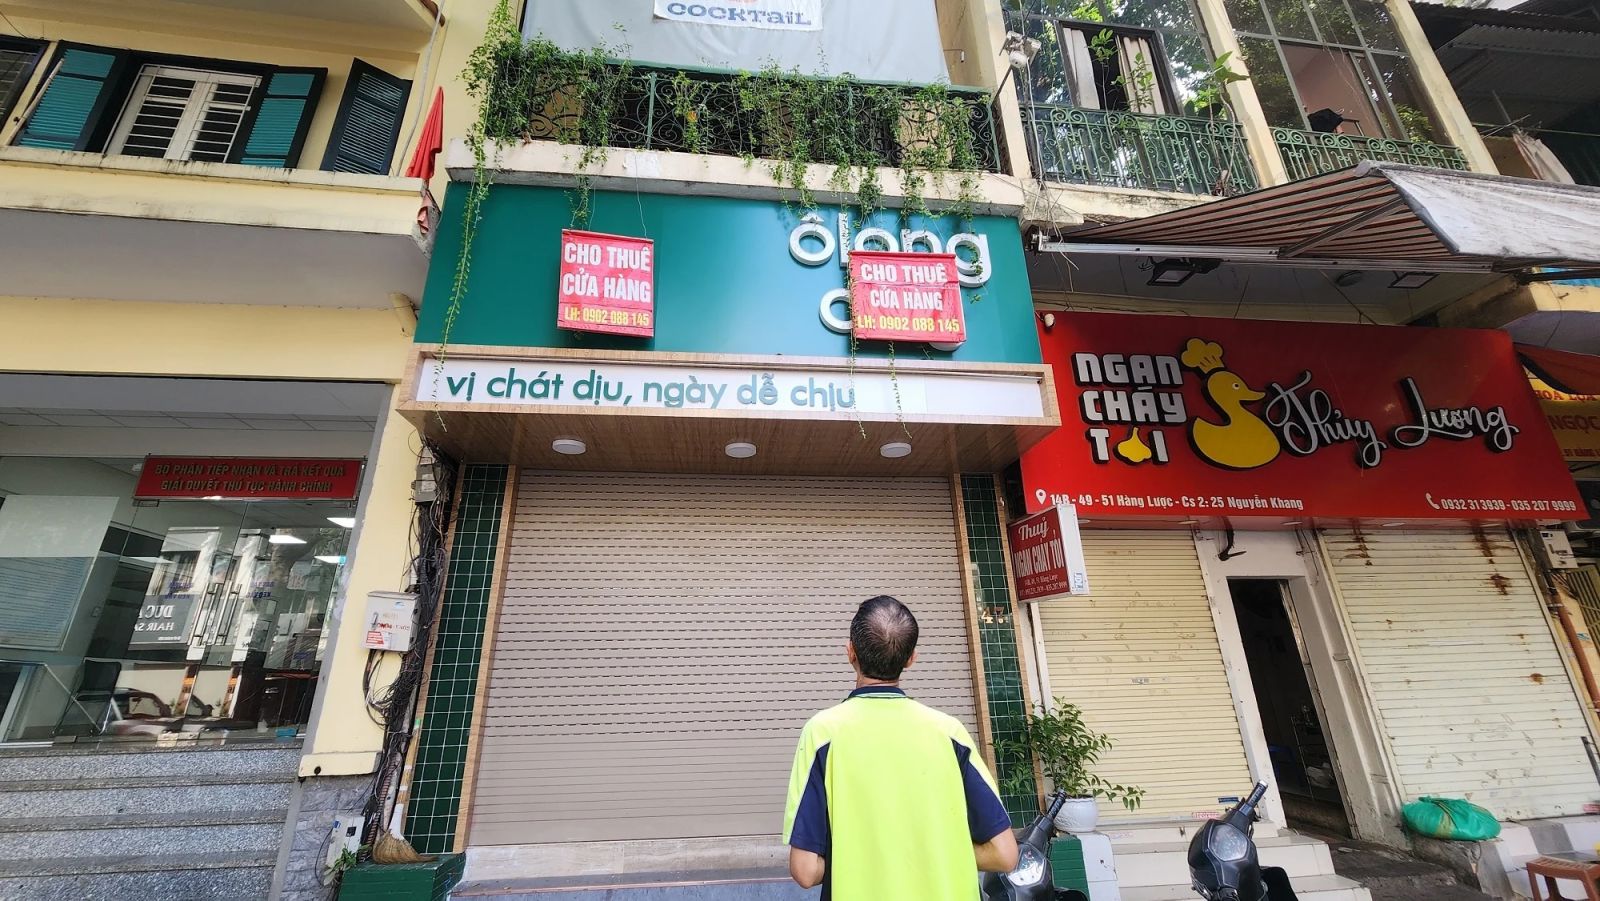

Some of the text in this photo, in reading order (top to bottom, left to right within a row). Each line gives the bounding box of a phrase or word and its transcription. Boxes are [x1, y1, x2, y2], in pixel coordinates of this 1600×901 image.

[564, 242, 651, 272] CHO THUÊ
[861, 262, 948, 283] CHO THUÊ
[562, 267, 651, 303] CỬA HÀNG
[904, 289, 943, 310] HÀNG
[564, 306, 650, 326] LH: 0902 088 145
[857, 315, 960, 333] LH: 0902 088 145
[1075, 353, 1184, 385] NGAN
[446, 368, 856, 412] vị chát dịu, ngày dễ chịu
[1082, 385, 1188, 423] CHÁY
[1079, 494, 1093, 506] 49
[1101, 494, 1114, 506] 51
[1117, 494, 1144, 509] Hàng
[1147, 495, 1173, 510] Lược
[1182, 496, 1196, 508] Cs
[1210, 496, 1224, 508] 25
[1228, 493, 1268, 511] Nguyễn
[1271, 497, 1304, 511] Khang
[1441, 498, 1467, 510] 0932
[1512, 500, 1531, 511] 035
[1533, 500, 1550, 511] 207
[1552, 500, 1577, 511] 9999
